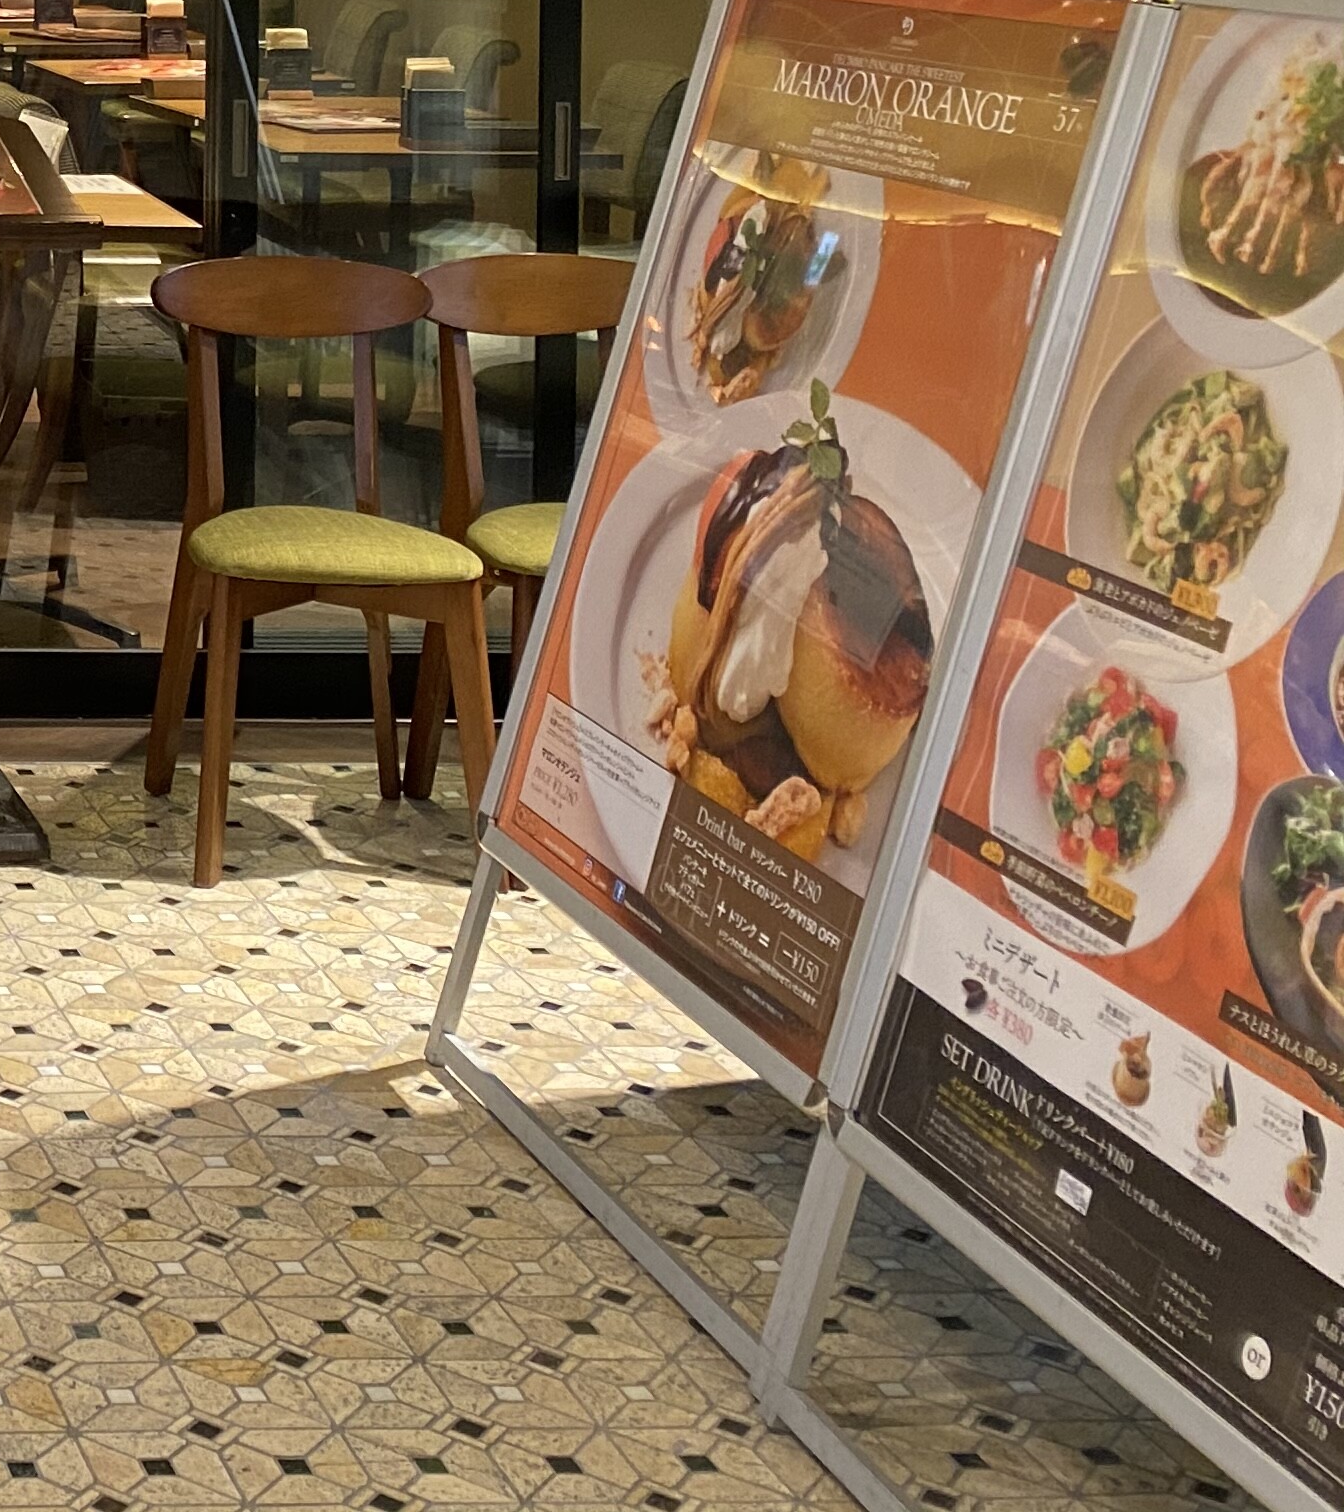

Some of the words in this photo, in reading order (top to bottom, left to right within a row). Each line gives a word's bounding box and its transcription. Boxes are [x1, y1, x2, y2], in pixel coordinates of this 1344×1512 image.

[773, 58, 891, 110] MARRON
[892, 78, 1024, 134] ORANGE
[696, 805, 727, 841] Drink
[726, 825, 747, 855] bar
[793, 868, 823, 905] ¥280
[727, 908, 758, 939] ドリンク
[983, 926, 1061, 995] ミニデザート
[940, 1032, 975, 1073] SET
[974, 1055, 1035, 1119] DRINK
[1247, 1348, 1266, 1369] or
